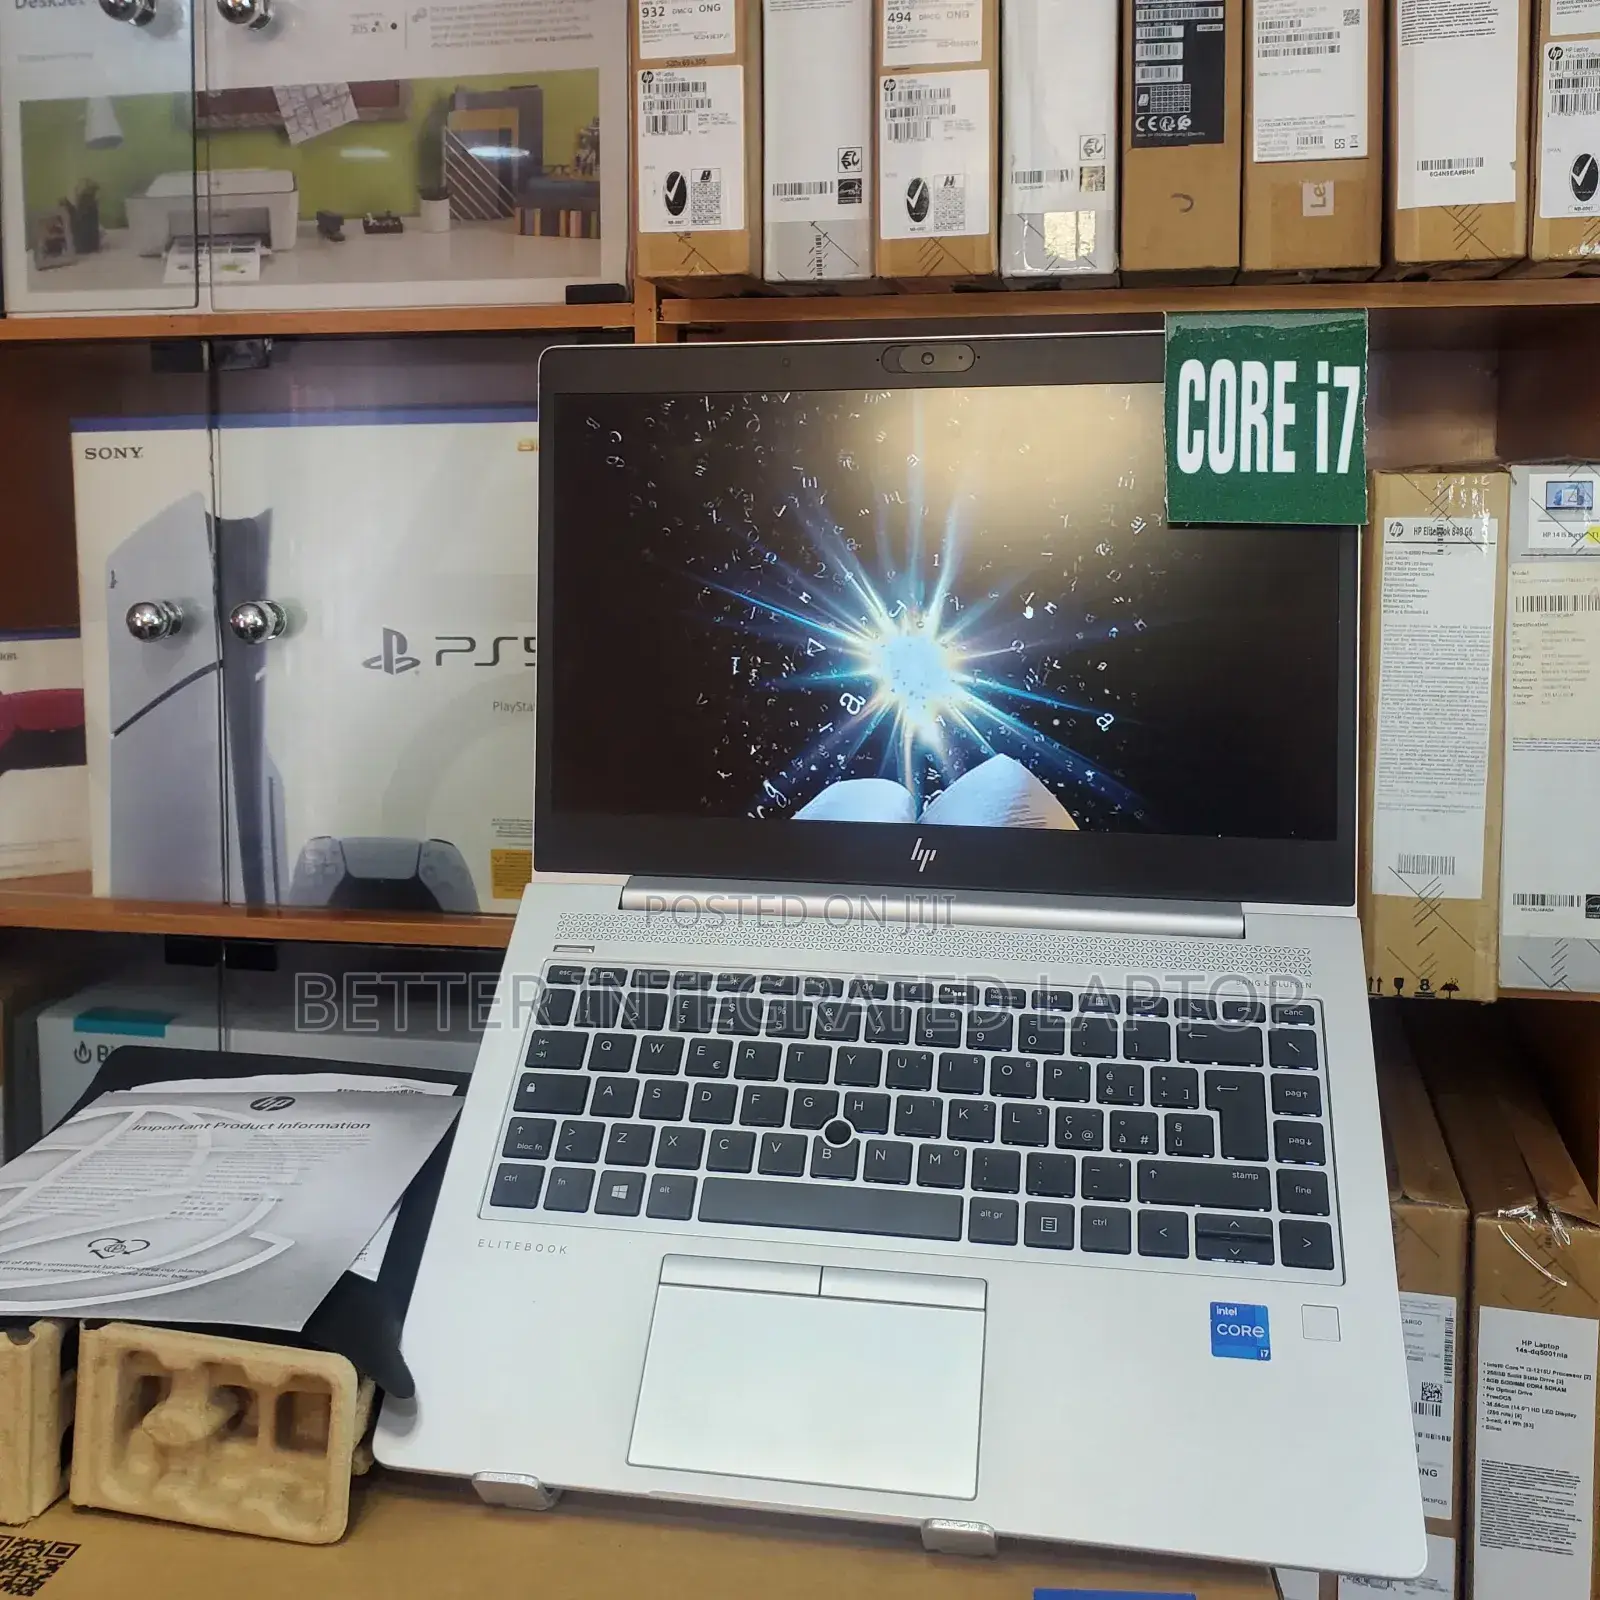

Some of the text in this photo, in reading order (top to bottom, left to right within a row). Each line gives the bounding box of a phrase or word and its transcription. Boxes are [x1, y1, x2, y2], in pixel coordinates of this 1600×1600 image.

[642, 6, 665, 18] 932
[699, 4, 721, 13] ONG
[887, 12, 912, 23] 494
[947, 10, 970, 19] ONG
[1177, 358, 1360, 474] CORE i7
[84, 447, 144, 460] SONY
[1413, 527, 1422, 536] HP
[1465, 527, 1473, 536] G6
[1236, 979, 1261, 987] BANG
[1271, 981, 1312, 989] OLUFSEN
[631, 1012, 638, 1021] 2
[678, 1014, 686, 1024] 3
[726, 1017, 734, 1027] 4
[925, 1029, 934, 1038] 8
[976, 1032, 985, 1042] 9
[601, 1040, 612, 1051] Q
[649, 1043, 664, 1054] W
[697, 1045, 706, 1056] E
[745, 1048, 756, 1059] R
[795, 1051, 804, 1062] T
[846, 1054, 857, 1065] Y
[897, 1057, 907, 1068] U
[1053, 1068, 1063, 1079] P
[603, 1085, 614, 1096] A
[652, 1088, 661, 1098] S
[701, 1091, 712, 1101] D
[751, 1094, 760, 1104] F
[803, 1097, 814, 1108] G
[853, 1100, 864, 1111] H
[905, 1104, 913, 1115] J
[958, 1108, 969, 1119] K
[1012, 1112, 1020, 1123] L
[132, 1121, 371, 1132] Important Product Information
[617, 1133, 627, 1144] Z
[668, 1135, 679, 1147] X
[1081, 1130, 1094, 1141] @
[517, 1142, 543, 1151] bloc fn
[719, 1139, 729, 1150] C
[771, 1142, 782, 1153] V
[822, 1149, 832, 1159] B
[876, 1150, 886, 1161] N
[929, 1153, 941, 1165] M
[504, 1174, 518, 1182] ctrl
[557, 1177, 566, 1186] fn
[1232, 1172, 1259, 1181] stamp
[659, 1185, 670, 1194] alt
[1295, 1185, 1312, 1195] fine
[980, 1209, 1003, 1219] alt gr
[1092, 1218, 1108, 1226] ctrl
[477, 1238, 568, 1255] ELITEBOOK
[1216, 1305, 1237, 1316] intel
[1534, 1341, 1560, 1350] Laptop
[1260, 1349, 1269, 1357] i7
[1553, 1370, 1583, 1379] Processor
[1544, 1384, 1567, 1393] SDRAM
[1486, 1393, 1512, 1401] FreeDOS
[1555, 1409, 1577, 1419] Display
